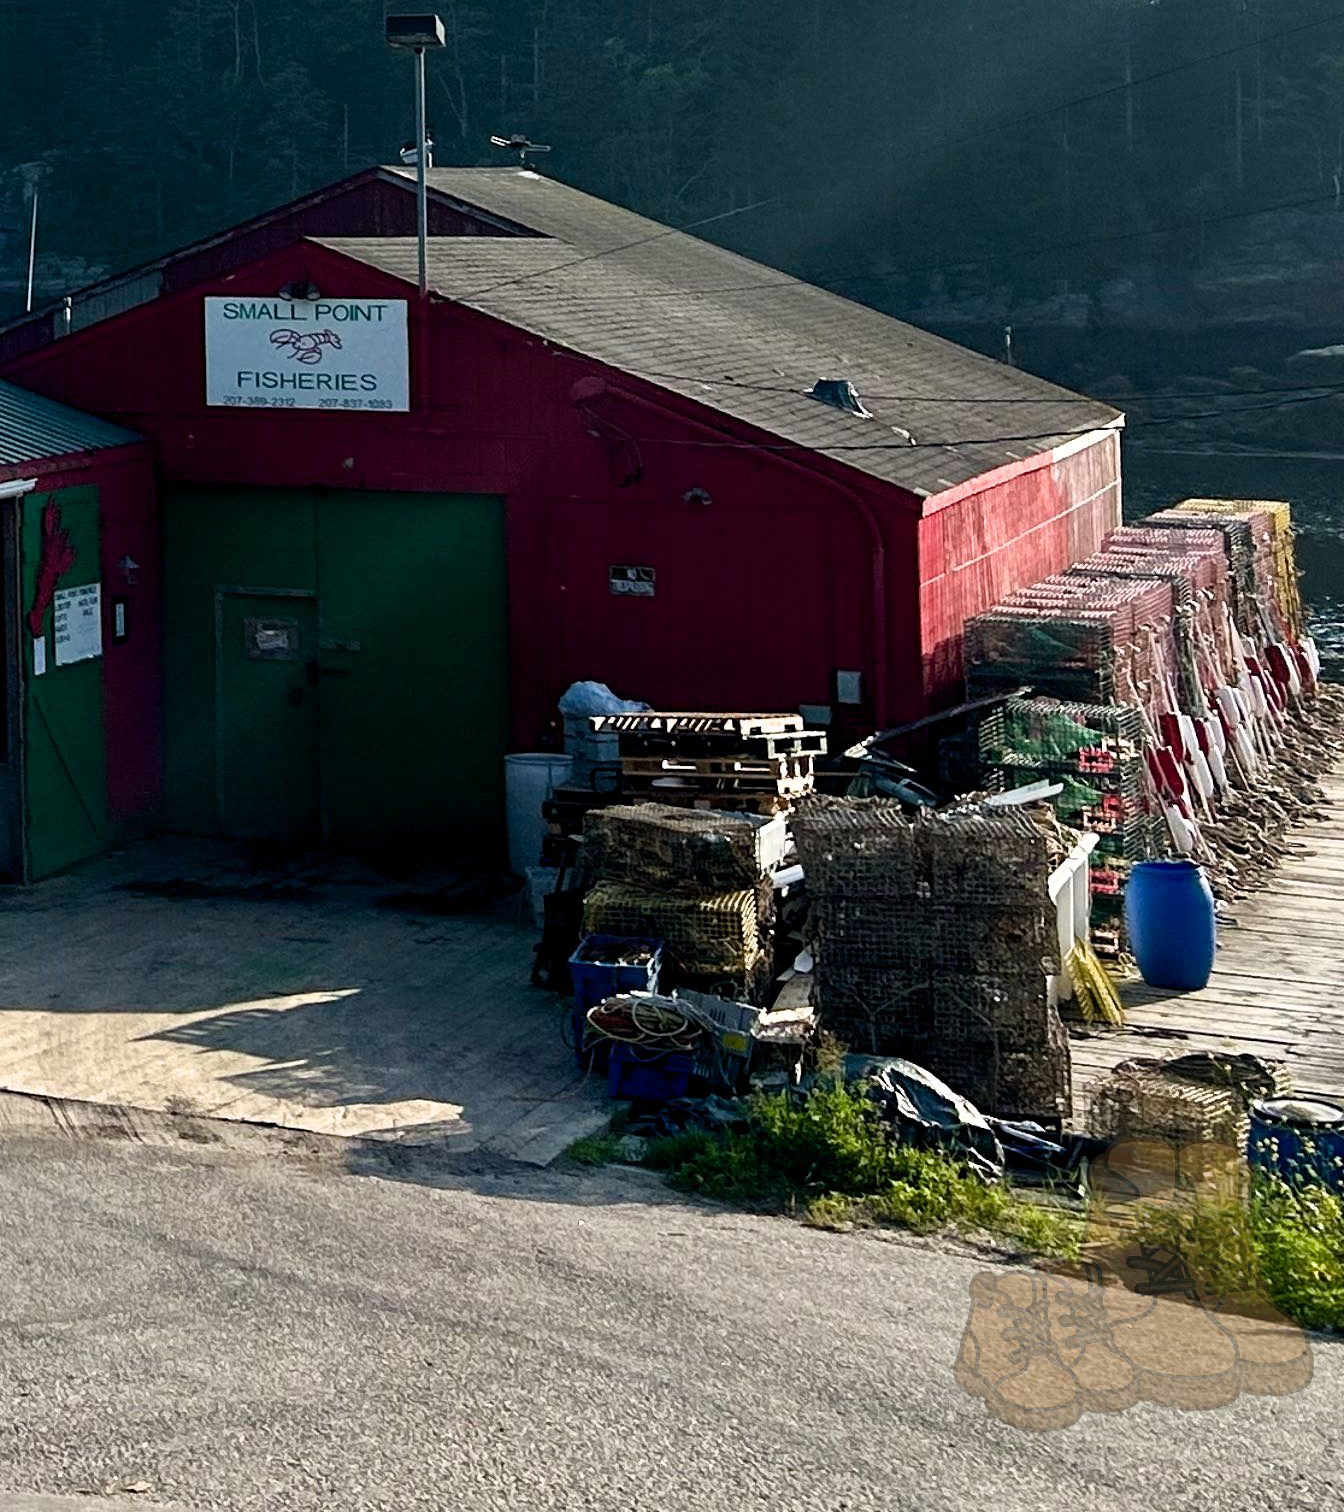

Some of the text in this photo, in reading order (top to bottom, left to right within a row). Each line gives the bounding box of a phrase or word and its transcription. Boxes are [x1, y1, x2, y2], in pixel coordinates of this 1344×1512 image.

[223, 302, 388, 322] SMALL POINT
[237, 370, 377, 391] FISHERIES
